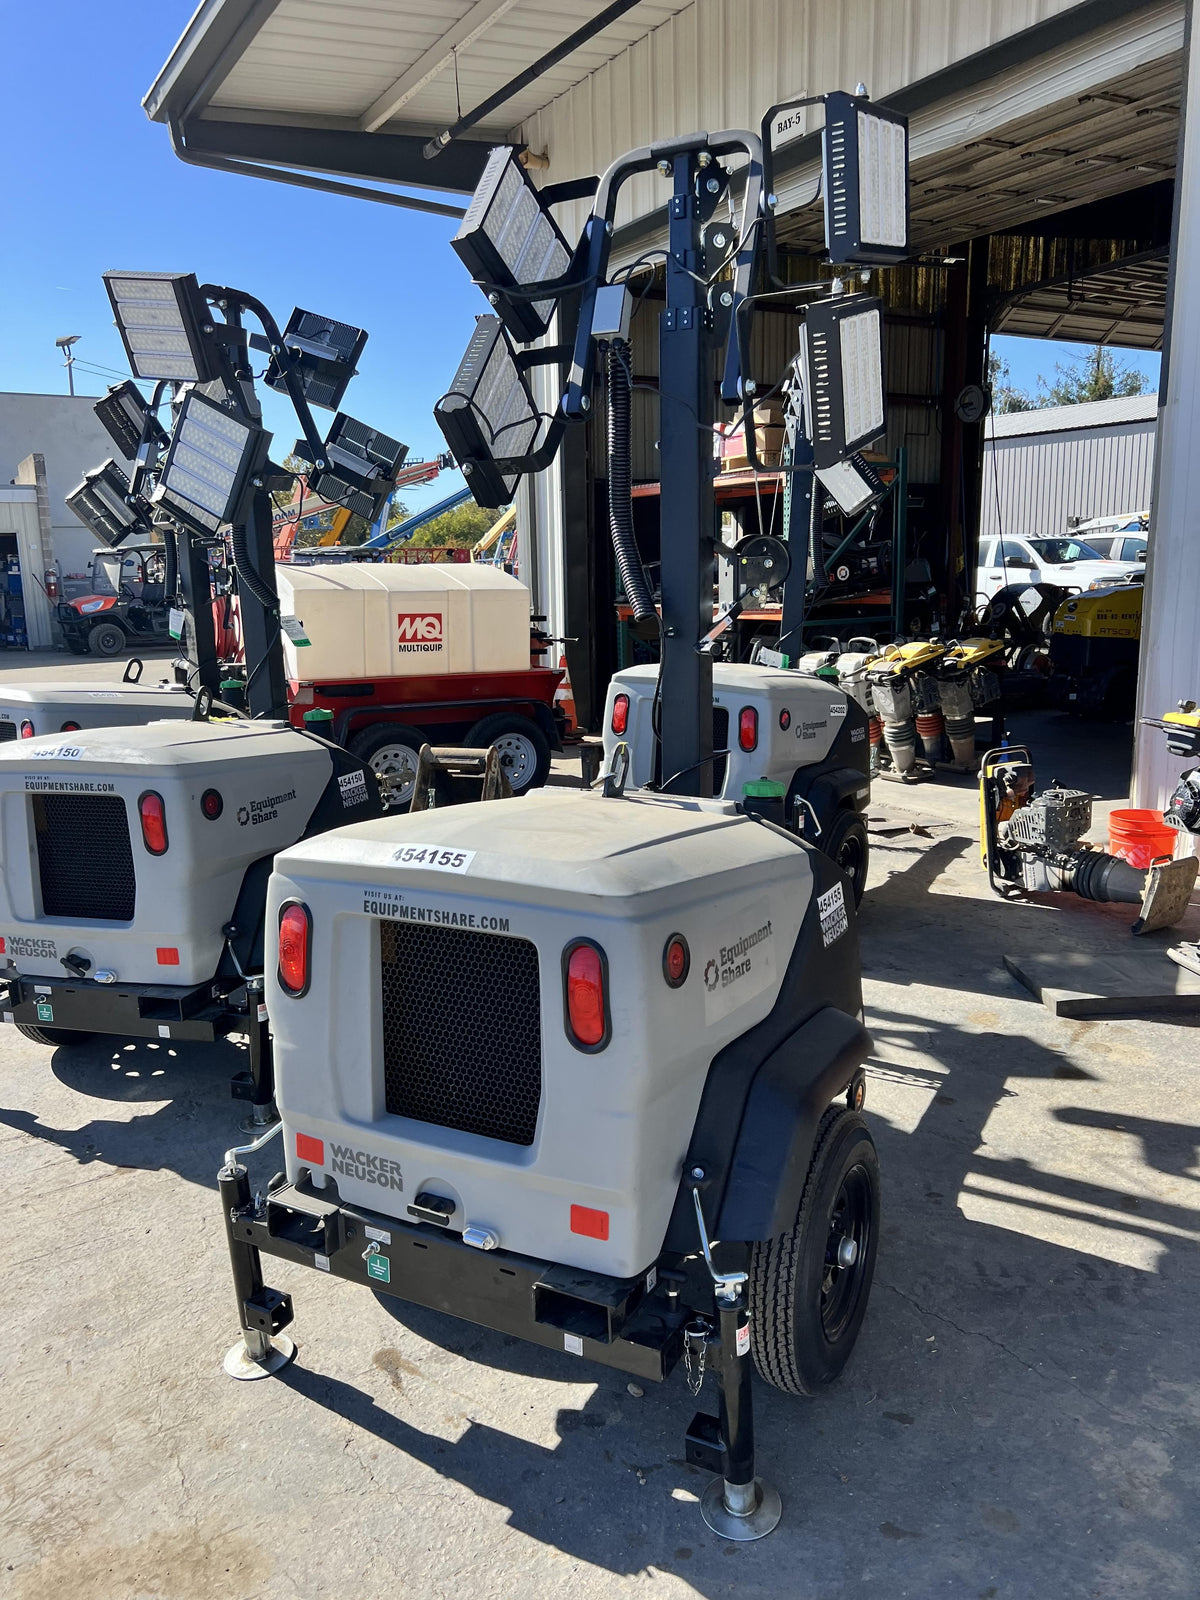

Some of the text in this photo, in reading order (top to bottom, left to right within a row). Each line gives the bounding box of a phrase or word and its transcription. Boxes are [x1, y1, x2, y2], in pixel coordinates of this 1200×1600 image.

[777, 111, 801, 134] BAY-5
[399, 616, 442, 640] MQ
[399, 644, 443, 653] MULTIQUIP
[25, 781, 115, 792] EQUIPMENTSHARE.COM
[340, 772, 363, 788] 454150
[249, 789, 297, 813] Equipment
[341, 784, 368, 801] WACKER
[342, 791, 369, 809] NEUSON
[251, 808, 278, 826] Share
[392, 847, 467, 868] 454155
[363, 889, 405, 902] VISIT US AT:
[818, 886, 842, 914] 454155
[363, 900, 510, 932] EQUIPMENTSHARE.COM
[820, 904, 847, 934] WACKER
[8, 936, 56, 949] WACKER
[719, 920, 773, 967] Equipment
[822, 916, 849, 948] NEUSON
[10, 946, 58, 959] NEUSON
[721, 957, 752, 989] Share
[329, 1142, 403, 1178] WACKER
[331, 1157, 404, 1192] NEUSON
